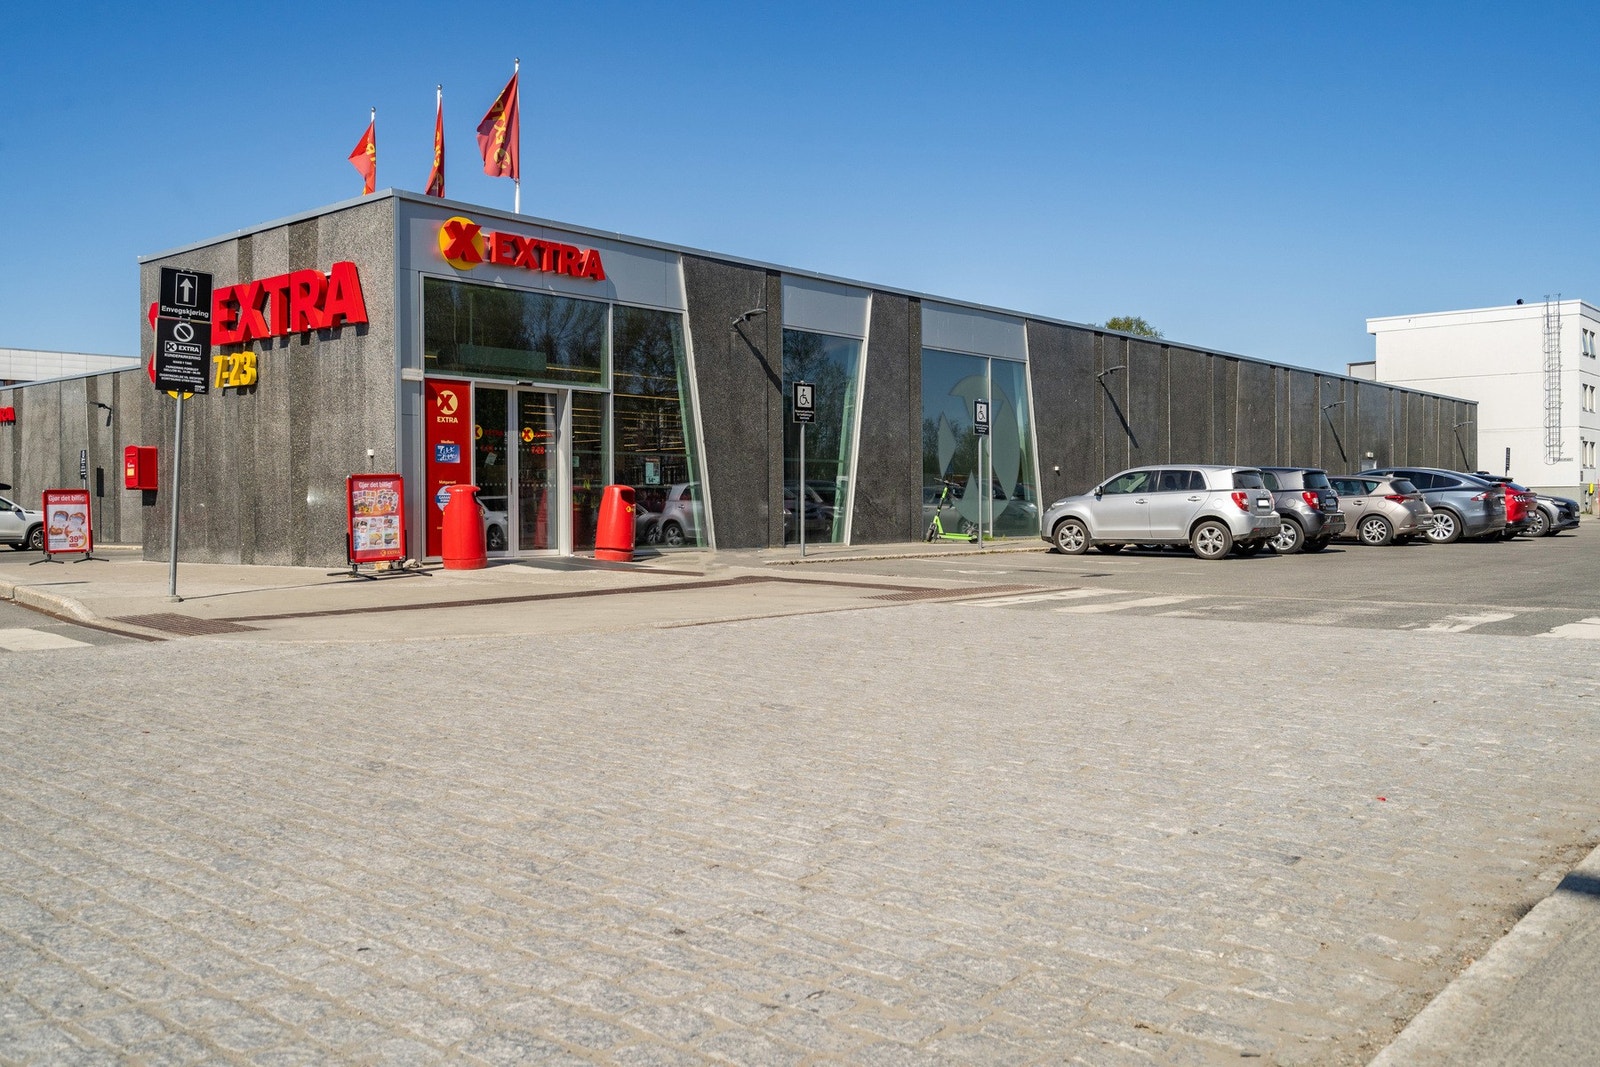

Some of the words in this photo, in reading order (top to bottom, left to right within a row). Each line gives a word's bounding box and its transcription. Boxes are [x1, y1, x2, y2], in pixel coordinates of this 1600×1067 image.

[490, 232, 606, 281] EXTRA
[211, 261, 368, 346] EXTRA
[161, 305, 209, 319] Envegskjøring
[178, 345, 200, 353] EXTRA
[212, 351, 257, 389] 7-23
[436, 416, 459, 424] EXTRA
[60, 494, 70, 502] det
